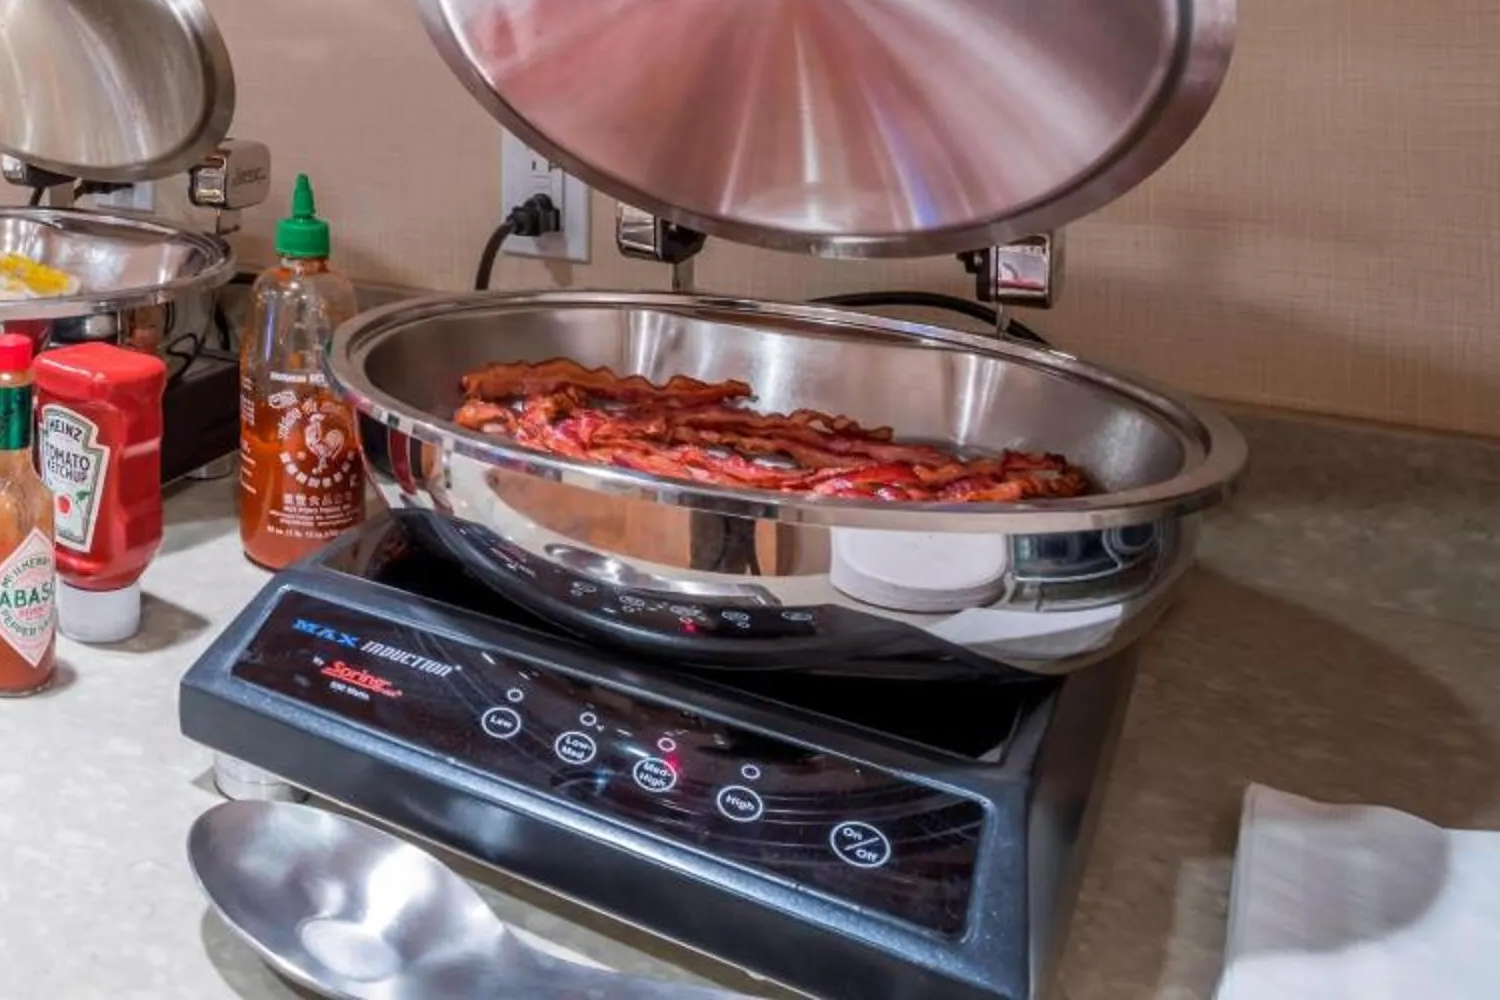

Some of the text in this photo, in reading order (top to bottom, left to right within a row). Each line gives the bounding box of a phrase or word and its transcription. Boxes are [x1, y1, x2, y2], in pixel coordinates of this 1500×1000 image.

[49, 419, 83, 443] HEINZ
[46, 441, 91, 471] TOMATO
[47, 459, 87, 483] KETCHUP
[360, 639, 453, 678] INDUCTION
[489, 714, 513, 729] Low
[561, 745, 585, 760] Med
[638, 773, 667, 790] High
[725, 794, 756, 812] High
[842, 826, 863, 841] On
[855, 848, 879, 862] Off
